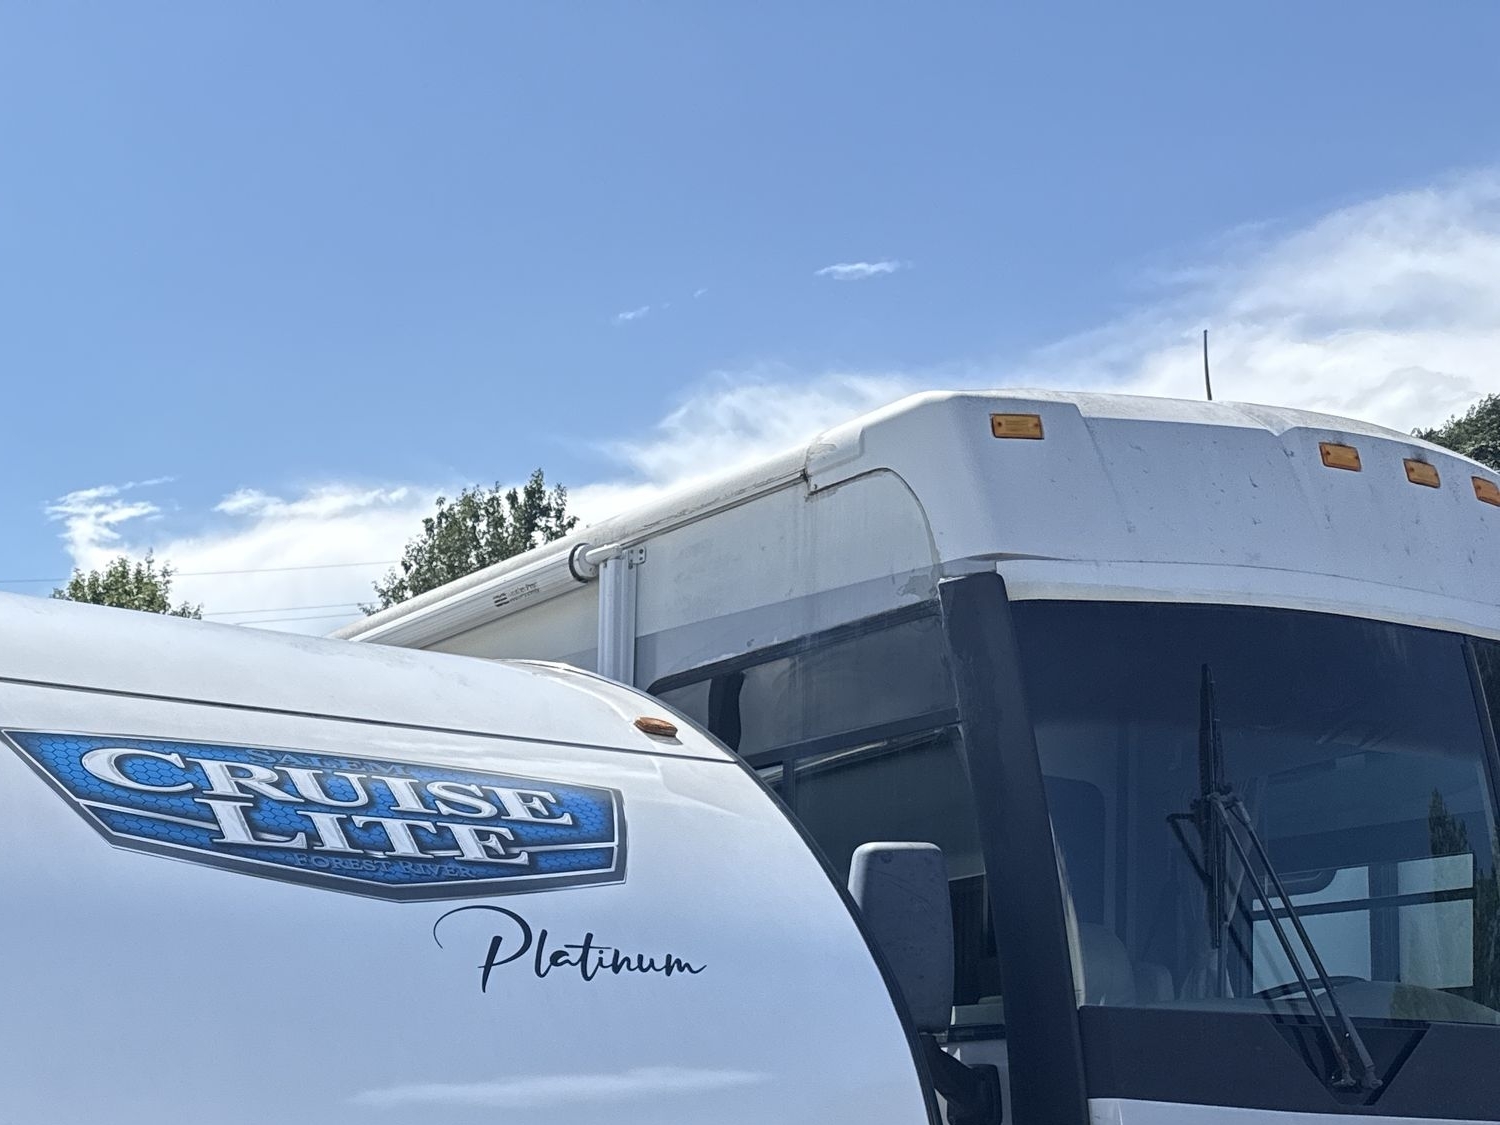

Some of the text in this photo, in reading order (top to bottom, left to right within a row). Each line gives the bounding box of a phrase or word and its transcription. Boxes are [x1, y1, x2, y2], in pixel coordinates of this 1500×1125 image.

[81, 747, 573, 826] CRUISE
[246, 750, 411, 776] SALEM
[195, 798, 530, 866] LITE
[294, 853, 476, 878] FOREST RIVER
[433, 904, 707, 993] Platinum
